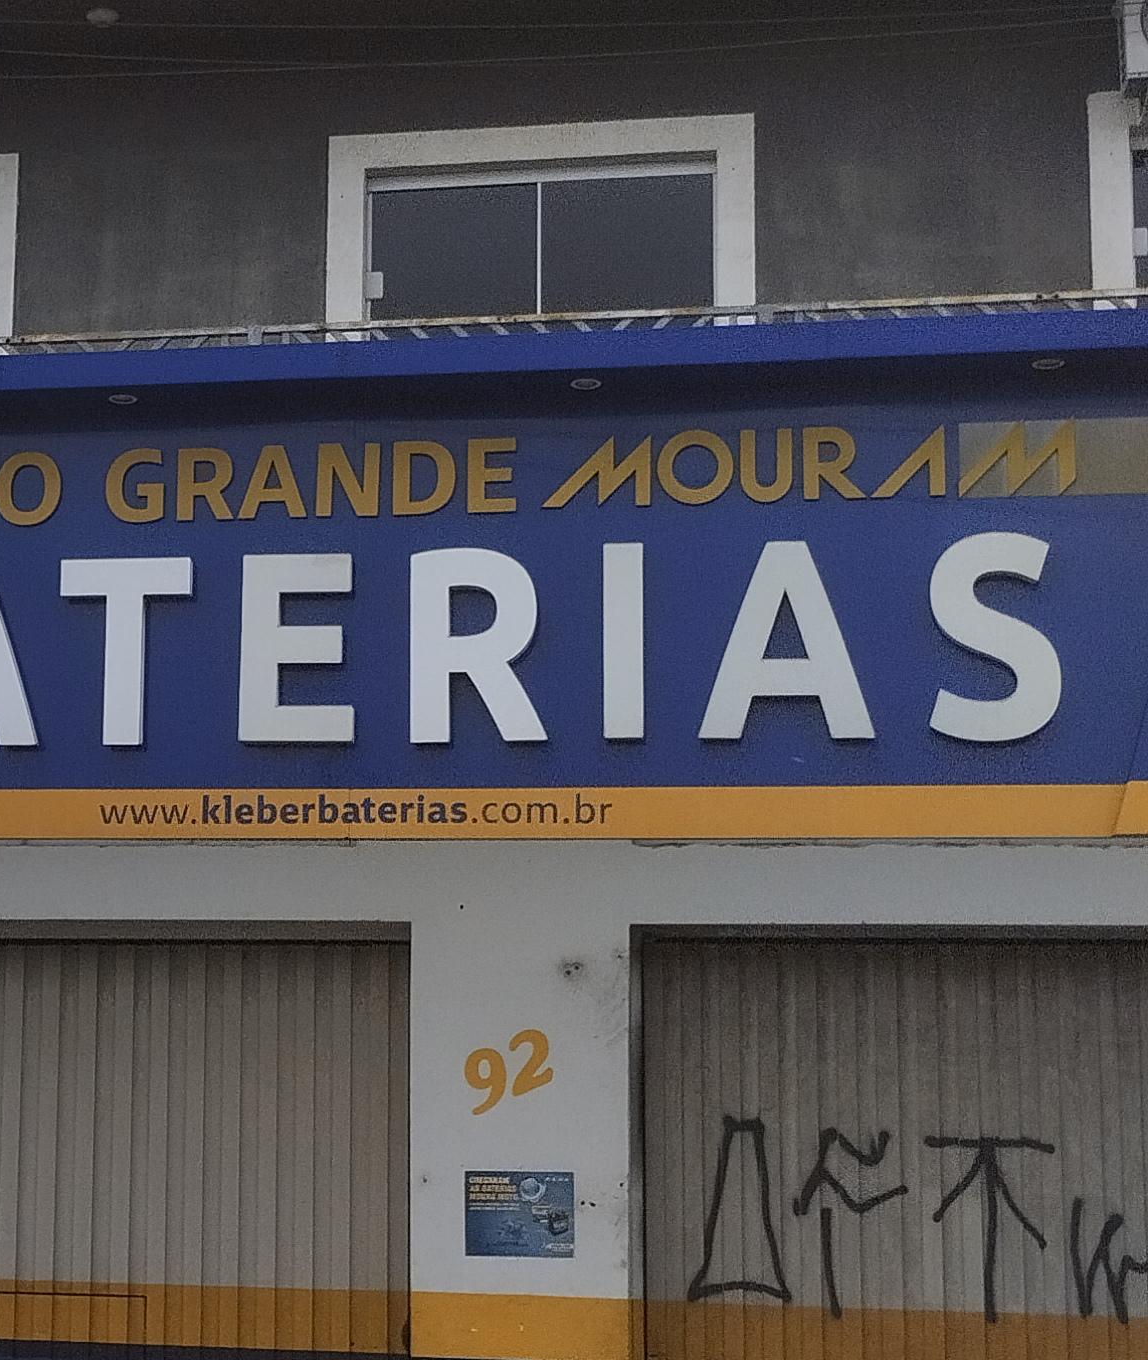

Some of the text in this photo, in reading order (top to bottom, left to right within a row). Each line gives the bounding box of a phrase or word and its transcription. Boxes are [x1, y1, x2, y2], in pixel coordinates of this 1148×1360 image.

[104, 437, 518, 524] GRANDE
[99, 793, 614, 826] www.kleberbaterias.com.br
[463, 1028, 554, 1116] 92
